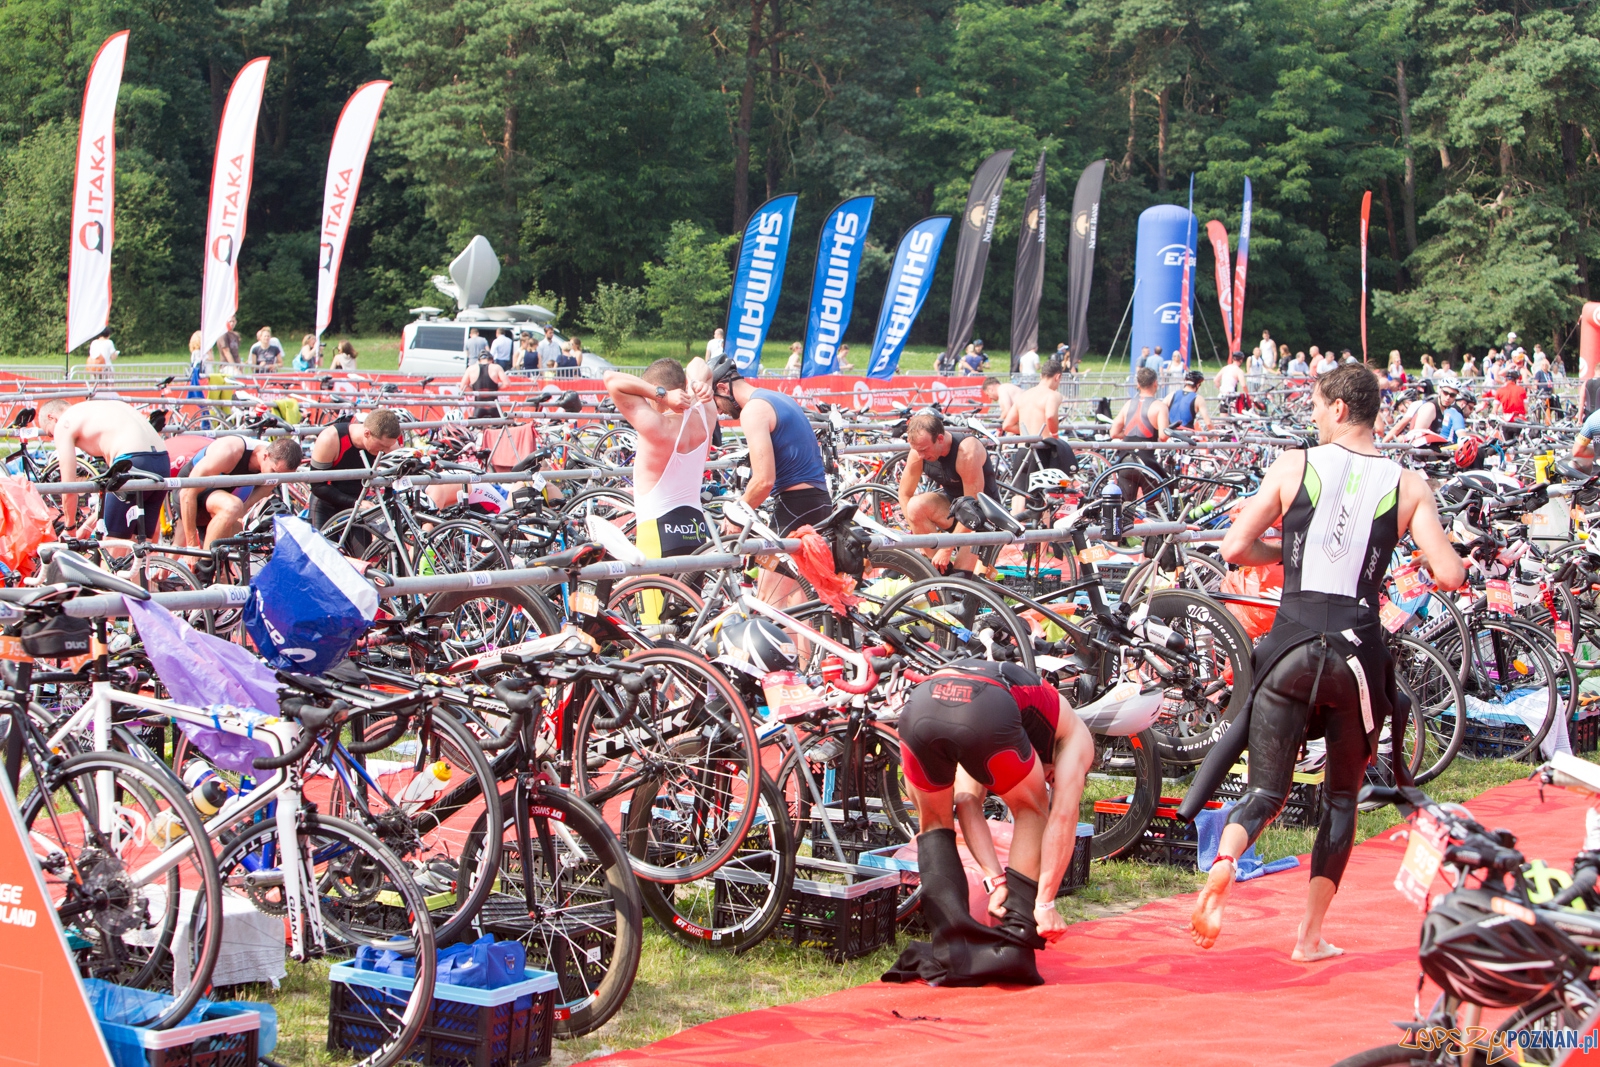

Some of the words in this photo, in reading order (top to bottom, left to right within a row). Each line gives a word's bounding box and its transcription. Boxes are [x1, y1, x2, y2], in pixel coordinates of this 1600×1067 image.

[88, 135, 105, 214] ITAKA
[222, 154, 245, 228] ITAKA
[324, 168, 353, 237] ITAKA
[734, 213, 783, 370] SHIMANO
[814, 211, 859, 367] SHIMANO
[476, 573, 489, 584] 801
[611, 562, 624, 573] 802
[228, 587, 247, 601] 800
[480, 643, 523, 660] AUTHOR
[531, 805, 550, 816] SWISS
[551, 808, 563, 819] DT
[288, 895, 299, 944] GIANT
[675, 917, 688, 928] DT
[686, 924, 704, 937] SWISS
[711, 930, 722, 940] 66
